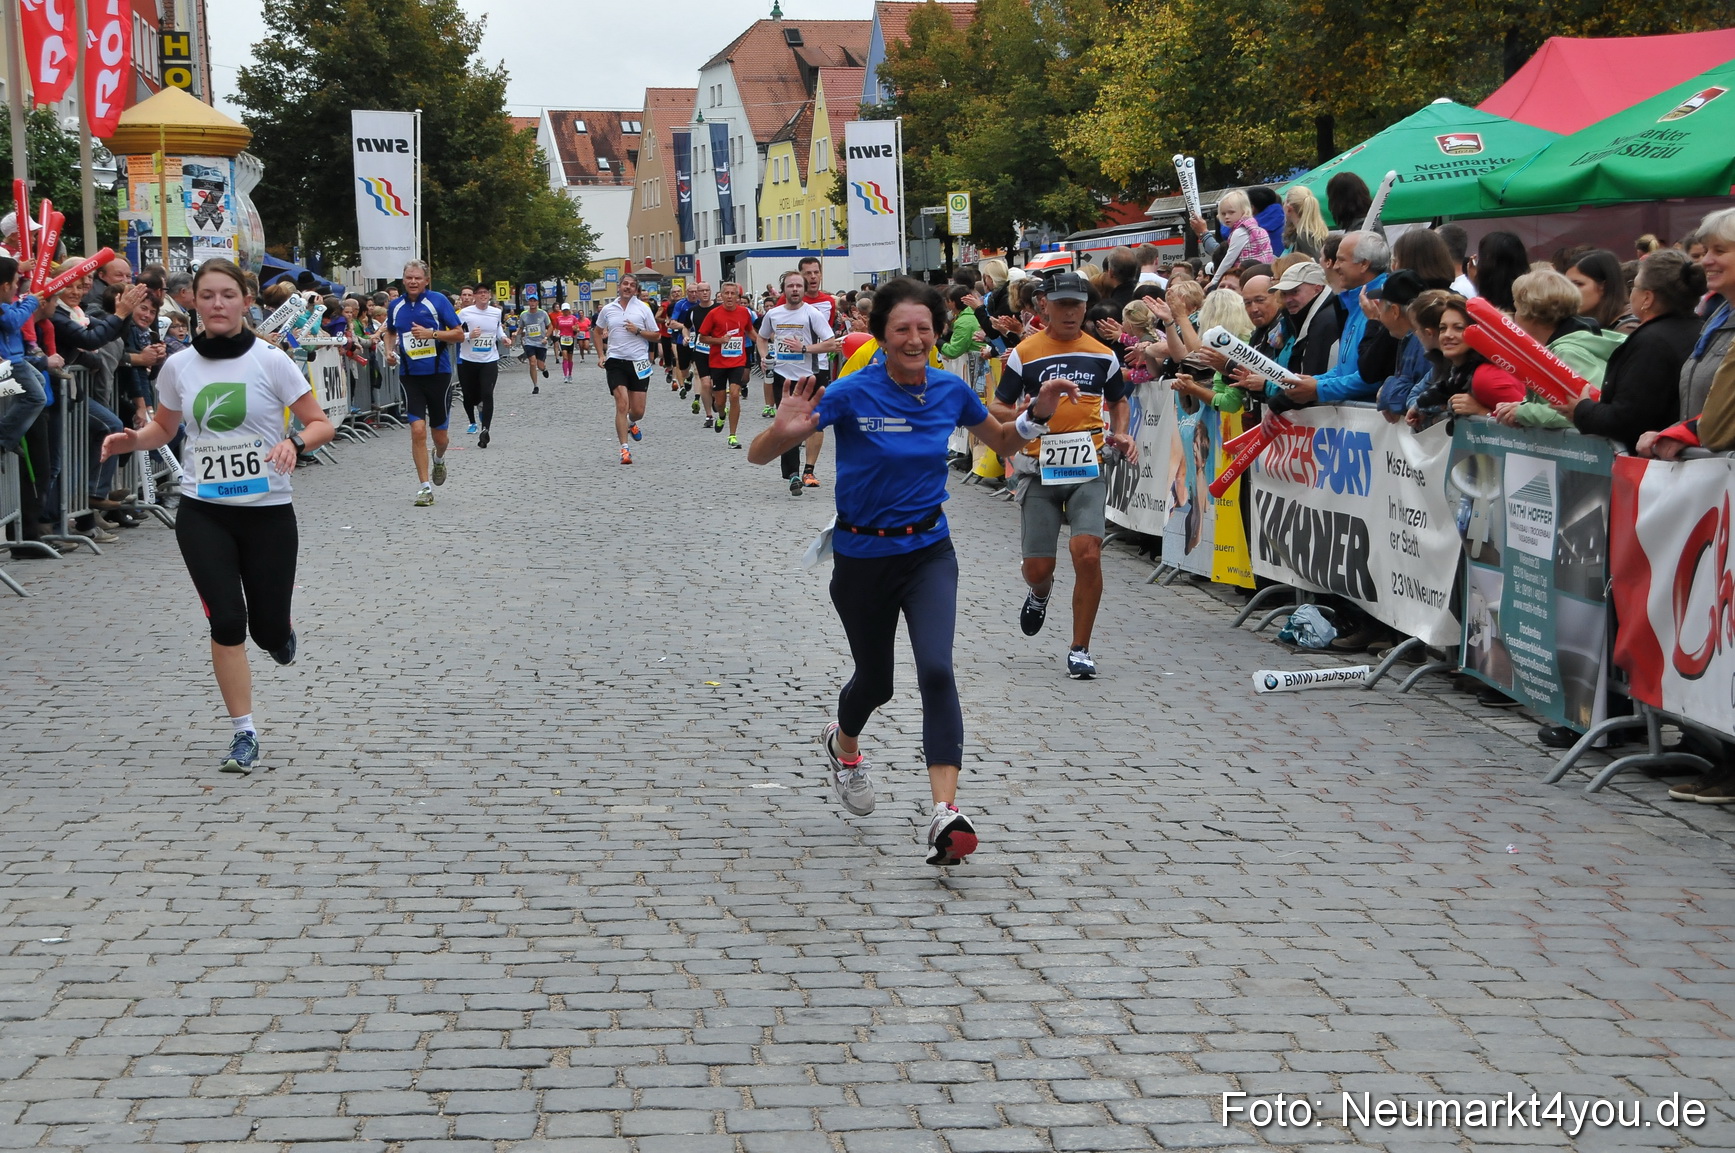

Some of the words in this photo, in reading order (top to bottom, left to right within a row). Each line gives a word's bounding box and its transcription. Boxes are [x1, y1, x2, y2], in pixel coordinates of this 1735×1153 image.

[1179, 170, 1189, 190] BMW
[144, 247, 188, 259] GLNN
[36, 266, 46, 285] Audi
[41, 252, 51, 267] BKK
[48, 279, 65, 293] Audi
[64, 271, 79, 284] BKK
[499, 287, 507, 296] D
[409, 337, 430, 349] 332
[474, 339, 492, 347] 2744
[723, 341, 742, 350] 2492
[1531, 340, 1554, 360] BKK
[1232, 343, 1262, 365] BMW
[1049, 369, 1096, 381] Fischer
[1553, 355, 1580, 379] Audi
[1525, 376, 1545, 395] BKK
[194, 445, 217, 454] PARTL
[217, 442, 252, 452] Neumarkt
[1059, 437, 1086, 445] Neumarkt
[1247, 438, 1261, 456] Audi
[1045, 444, 1093, 466] 2772
[1236, 454, 1249, 467] BKK
[201, 451, 261, 480] 2156
[1053, 469, 1087, 478] Friedrich
[217, 484, 249, 496] Carina
[1527, 506, 1553, 526] HOFFER
[1672, 488, 1735, 681] Ch
[1283, 672, 1313, 687] BMW
